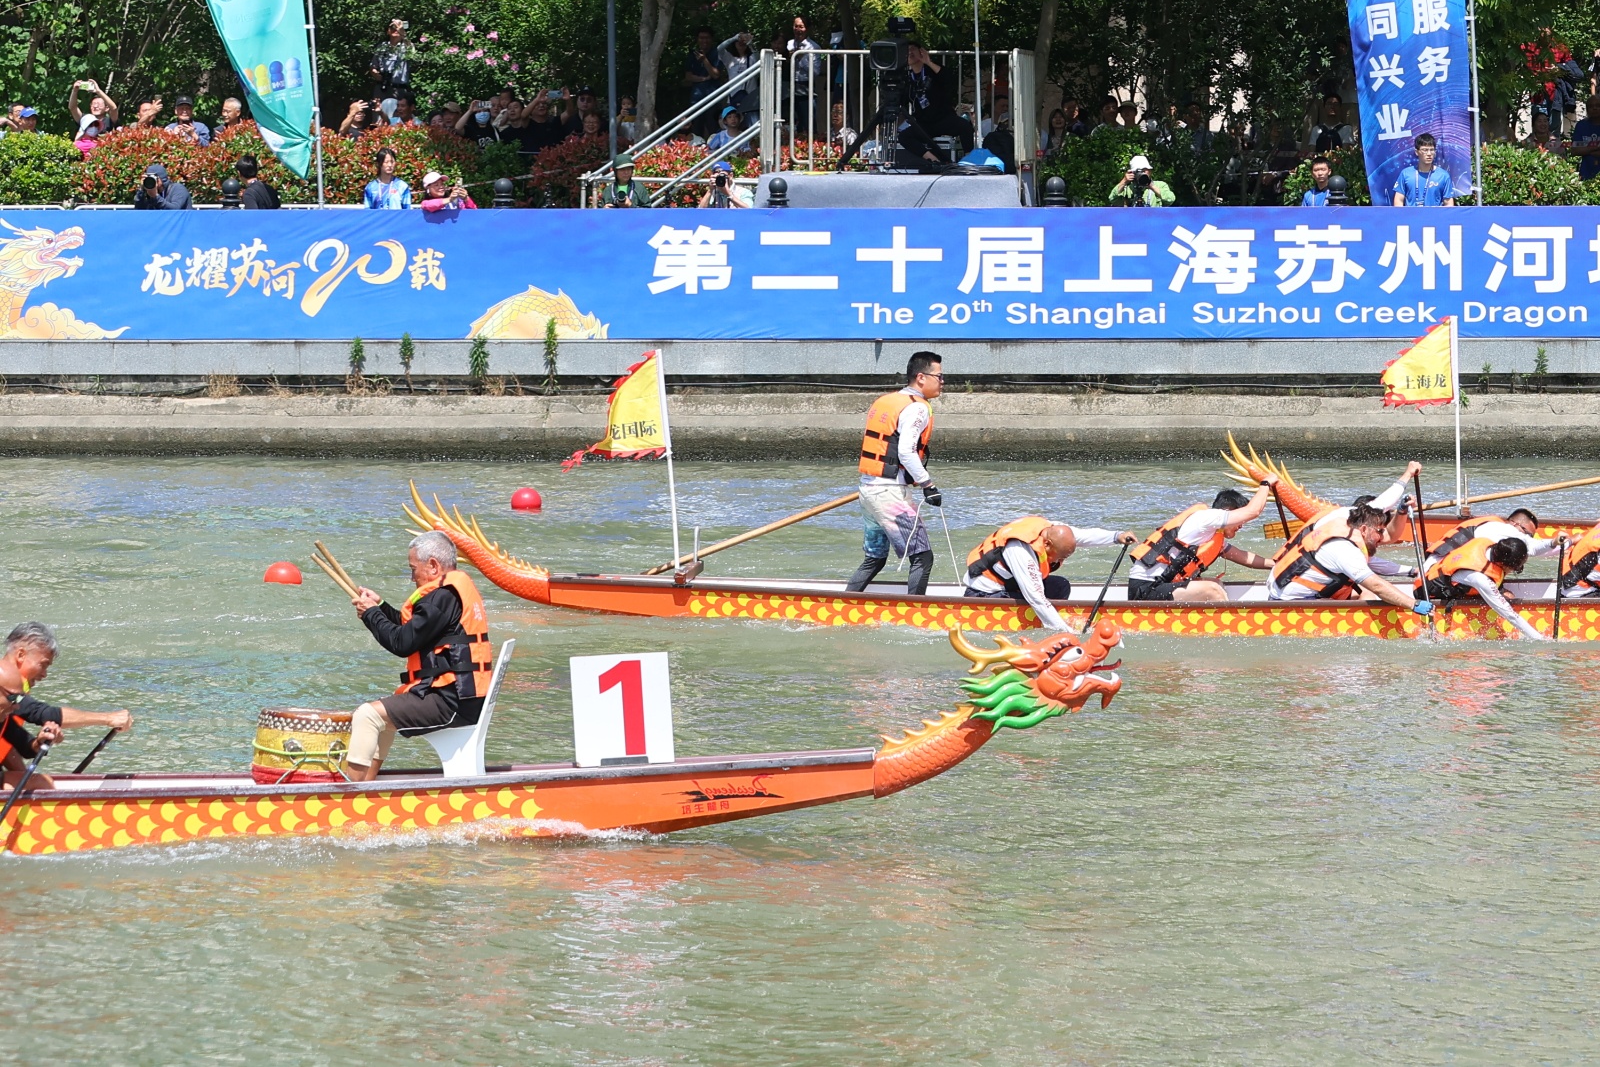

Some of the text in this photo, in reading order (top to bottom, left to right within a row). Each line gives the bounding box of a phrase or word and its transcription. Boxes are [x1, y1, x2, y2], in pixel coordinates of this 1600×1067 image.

[851, 303, 914, 324] The
[929, 299, 992, 325] 20th
[1006, 303, 1166, 329] Shanghai
[1193, 302, 1320, 323] Suzhou
[1336, 301, 1437, 323] Creek
[1464, 301, 1587, 327] Dragon
[1405, 374, 1447, 390] 上海龙
[599, 660, 646, 756] 1
